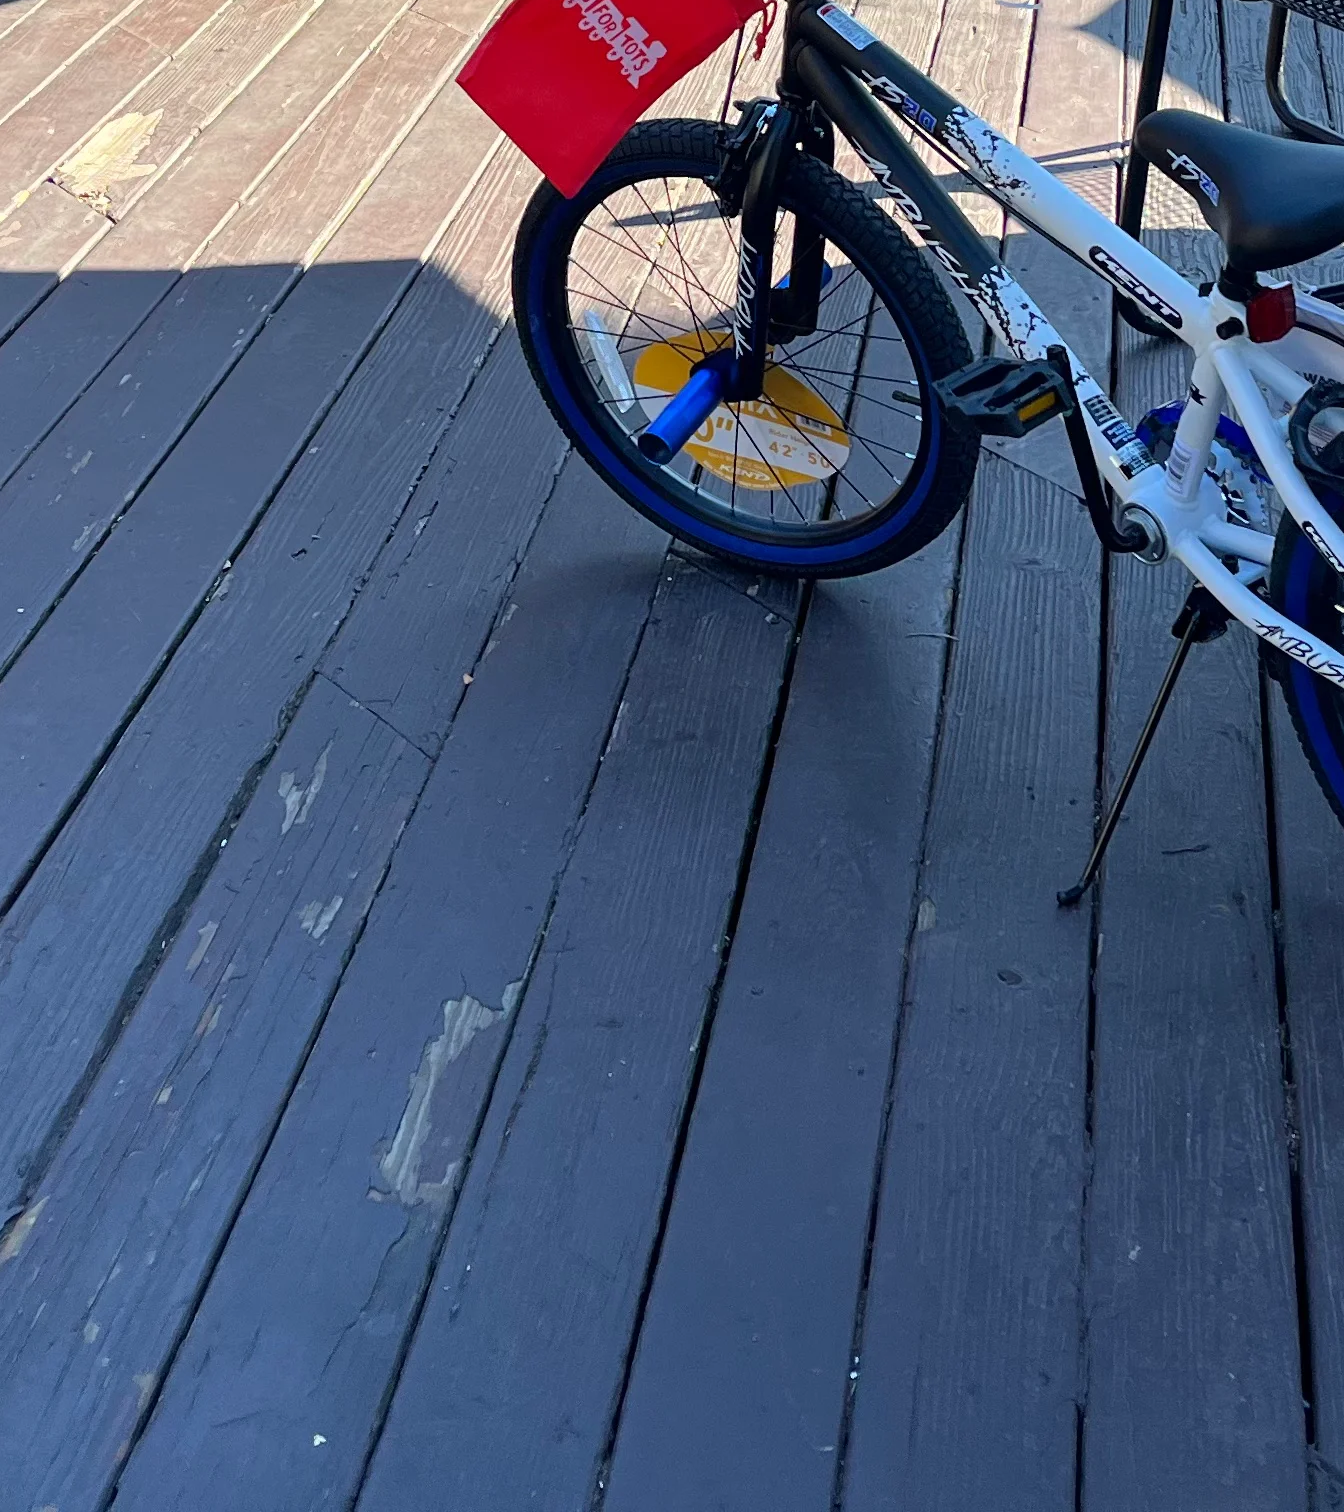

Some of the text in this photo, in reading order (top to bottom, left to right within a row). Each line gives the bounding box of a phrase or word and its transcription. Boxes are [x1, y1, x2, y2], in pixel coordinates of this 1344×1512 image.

[594, 2, 618, 35] FOR
[621, 33, 651, 73] TOTS
[1092, 249, 1182, 328] KENT
